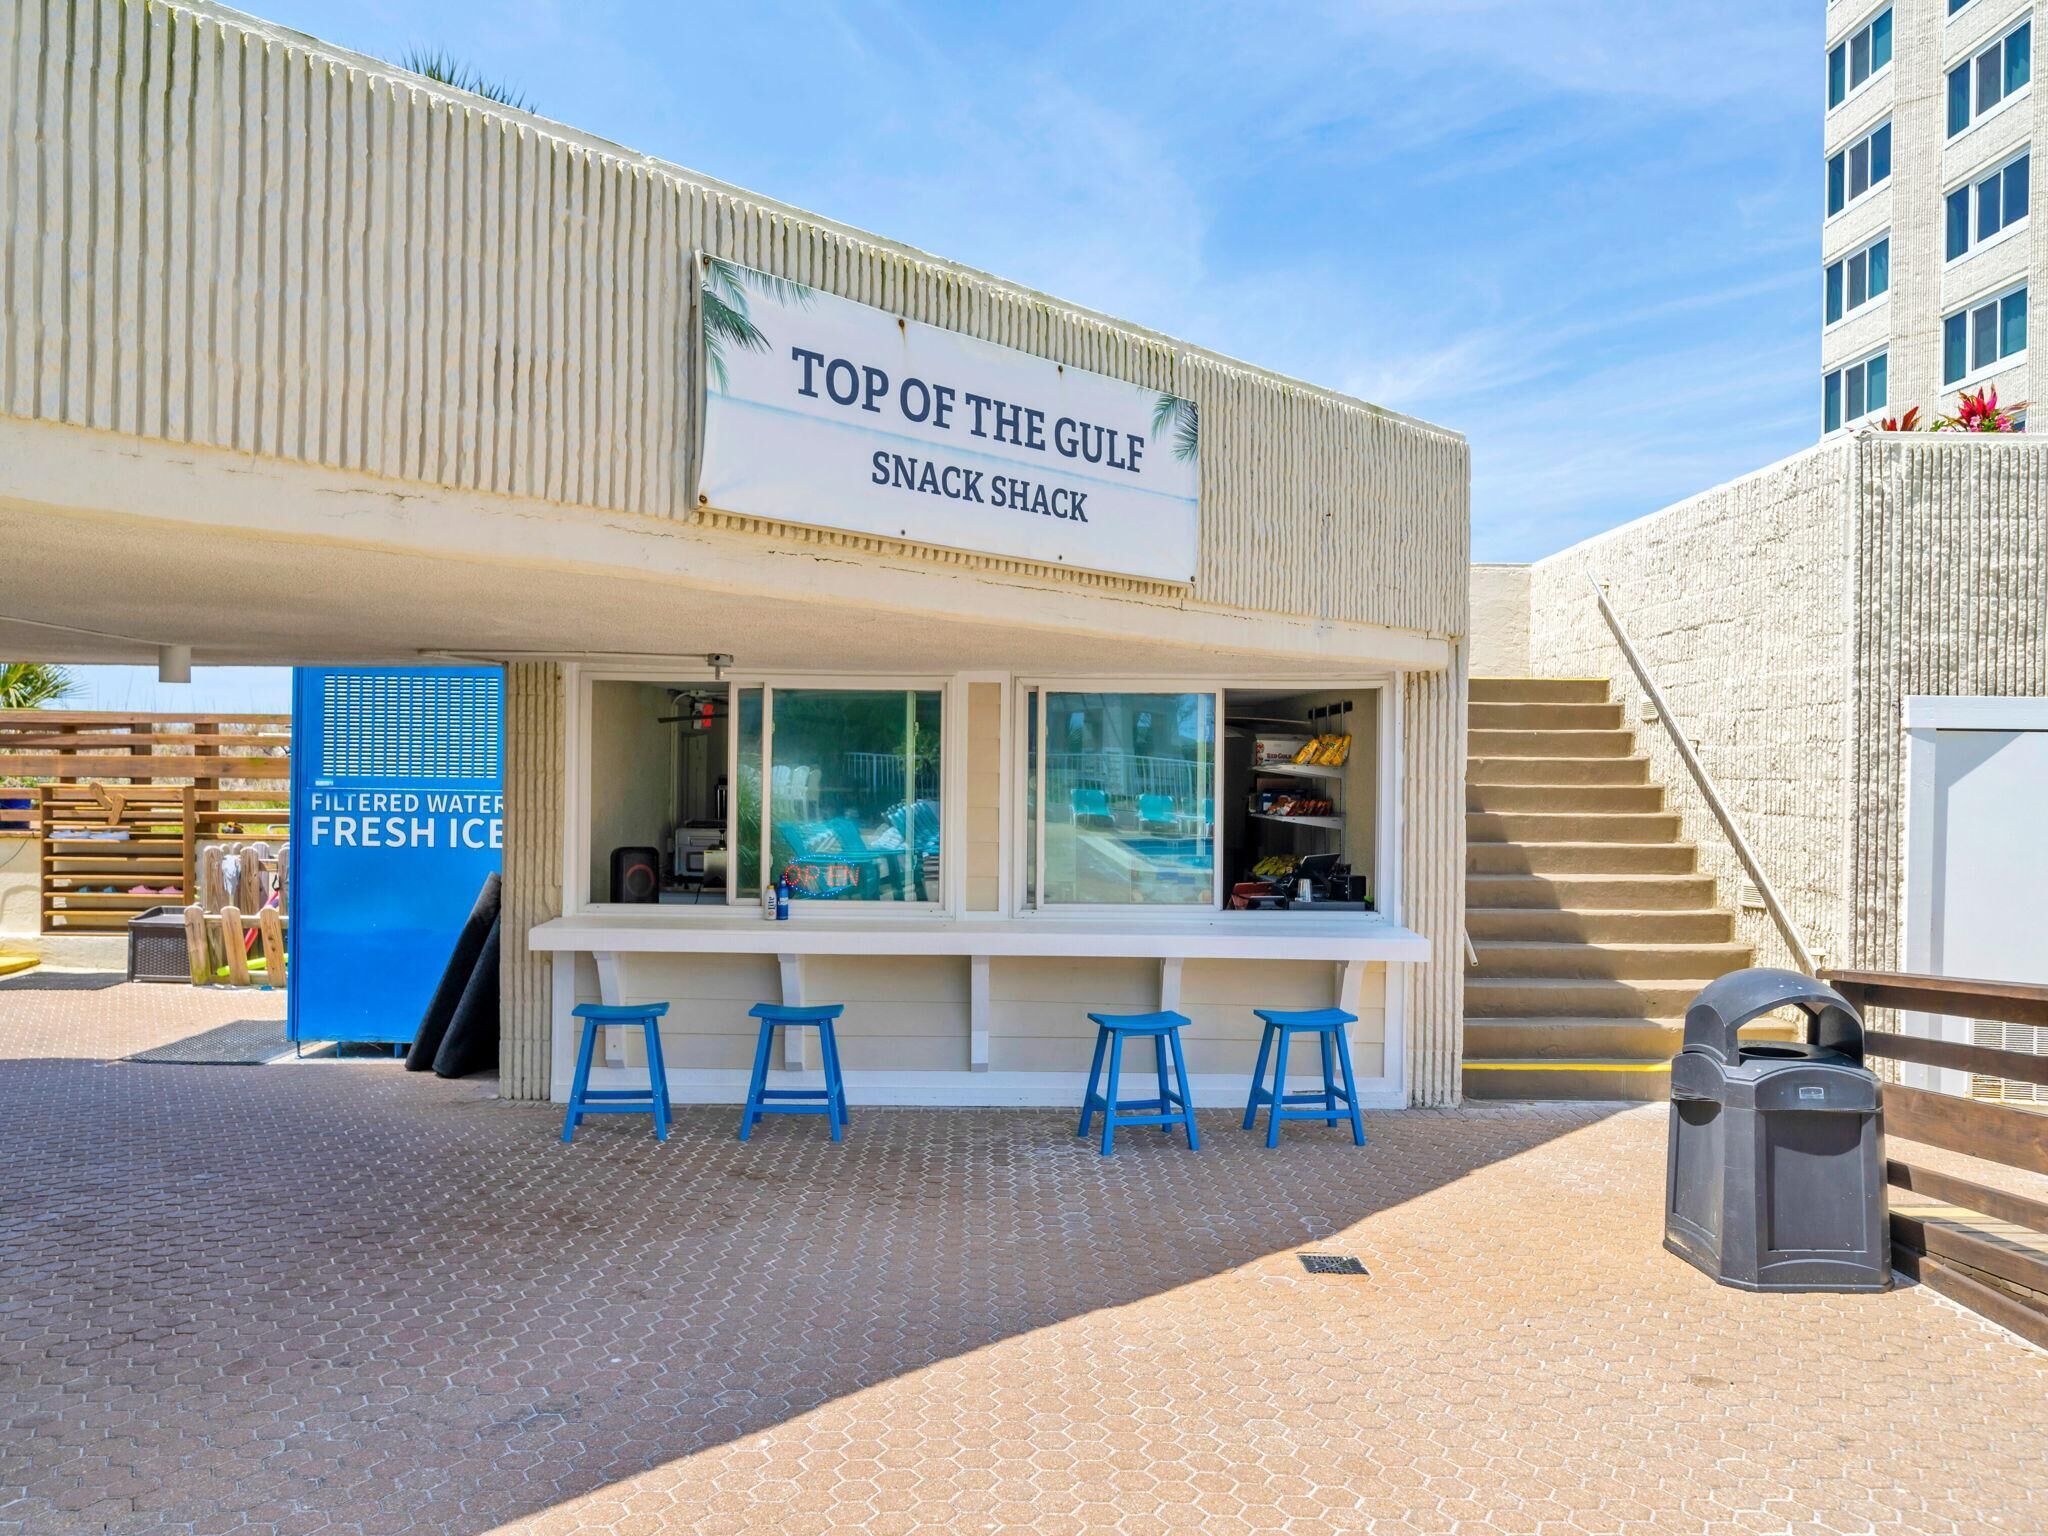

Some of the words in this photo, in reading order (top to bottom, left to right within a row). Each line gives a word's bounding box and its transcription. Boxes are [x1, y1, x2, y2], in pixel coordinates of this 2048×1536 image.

[791, 346, 889, 414] TOP
[899, 377, 956, 429] OF
[965, 391, 1046, 452] THE
[1054, 416, 1145, 473] GULF
[871, 451, 984, 503] SNACK
[991, 475, 1089, 523] SHACK
[311, 793, 419, 812] FILTERED
[426, 794, 503, 813] WATER
[311, 816, 435, 847] FRESH
[449, 818, 503, 849] ICE
[784, 865, 860, 887] OPEN
